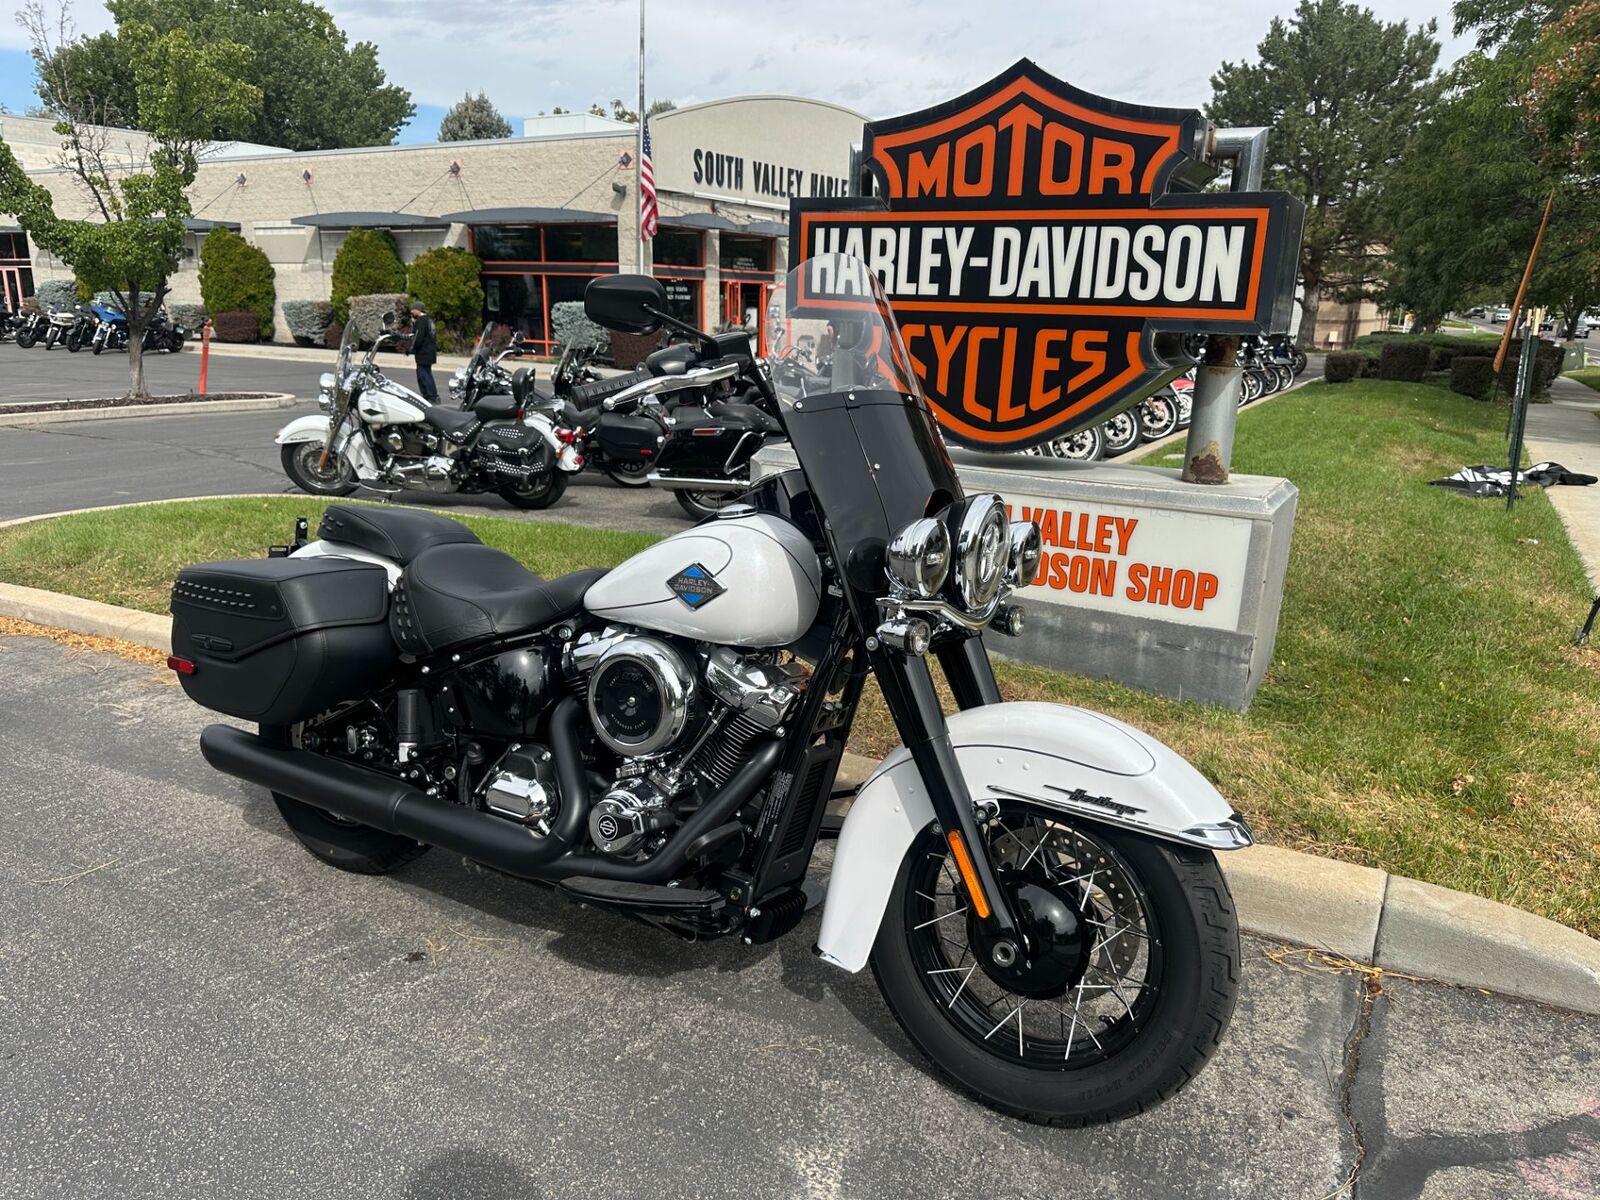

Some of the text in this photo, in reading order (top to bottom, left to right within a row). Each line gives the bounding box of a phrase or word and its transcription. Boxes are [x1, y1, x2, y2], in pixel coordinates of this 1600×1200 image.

[693, 148, 744, 191] SOUTH
[753, 161, 803, 198] VALLEY
[906, 102, 1136, 198] MOTOR
[811, 224, 1246, 303] HARLEY-DAVIDSON
[900, 323, 1109, 424] CYCLES
[674, 584, 713, 595] DAVIDSON
[1126, 563, 1219, 611] SHOP
